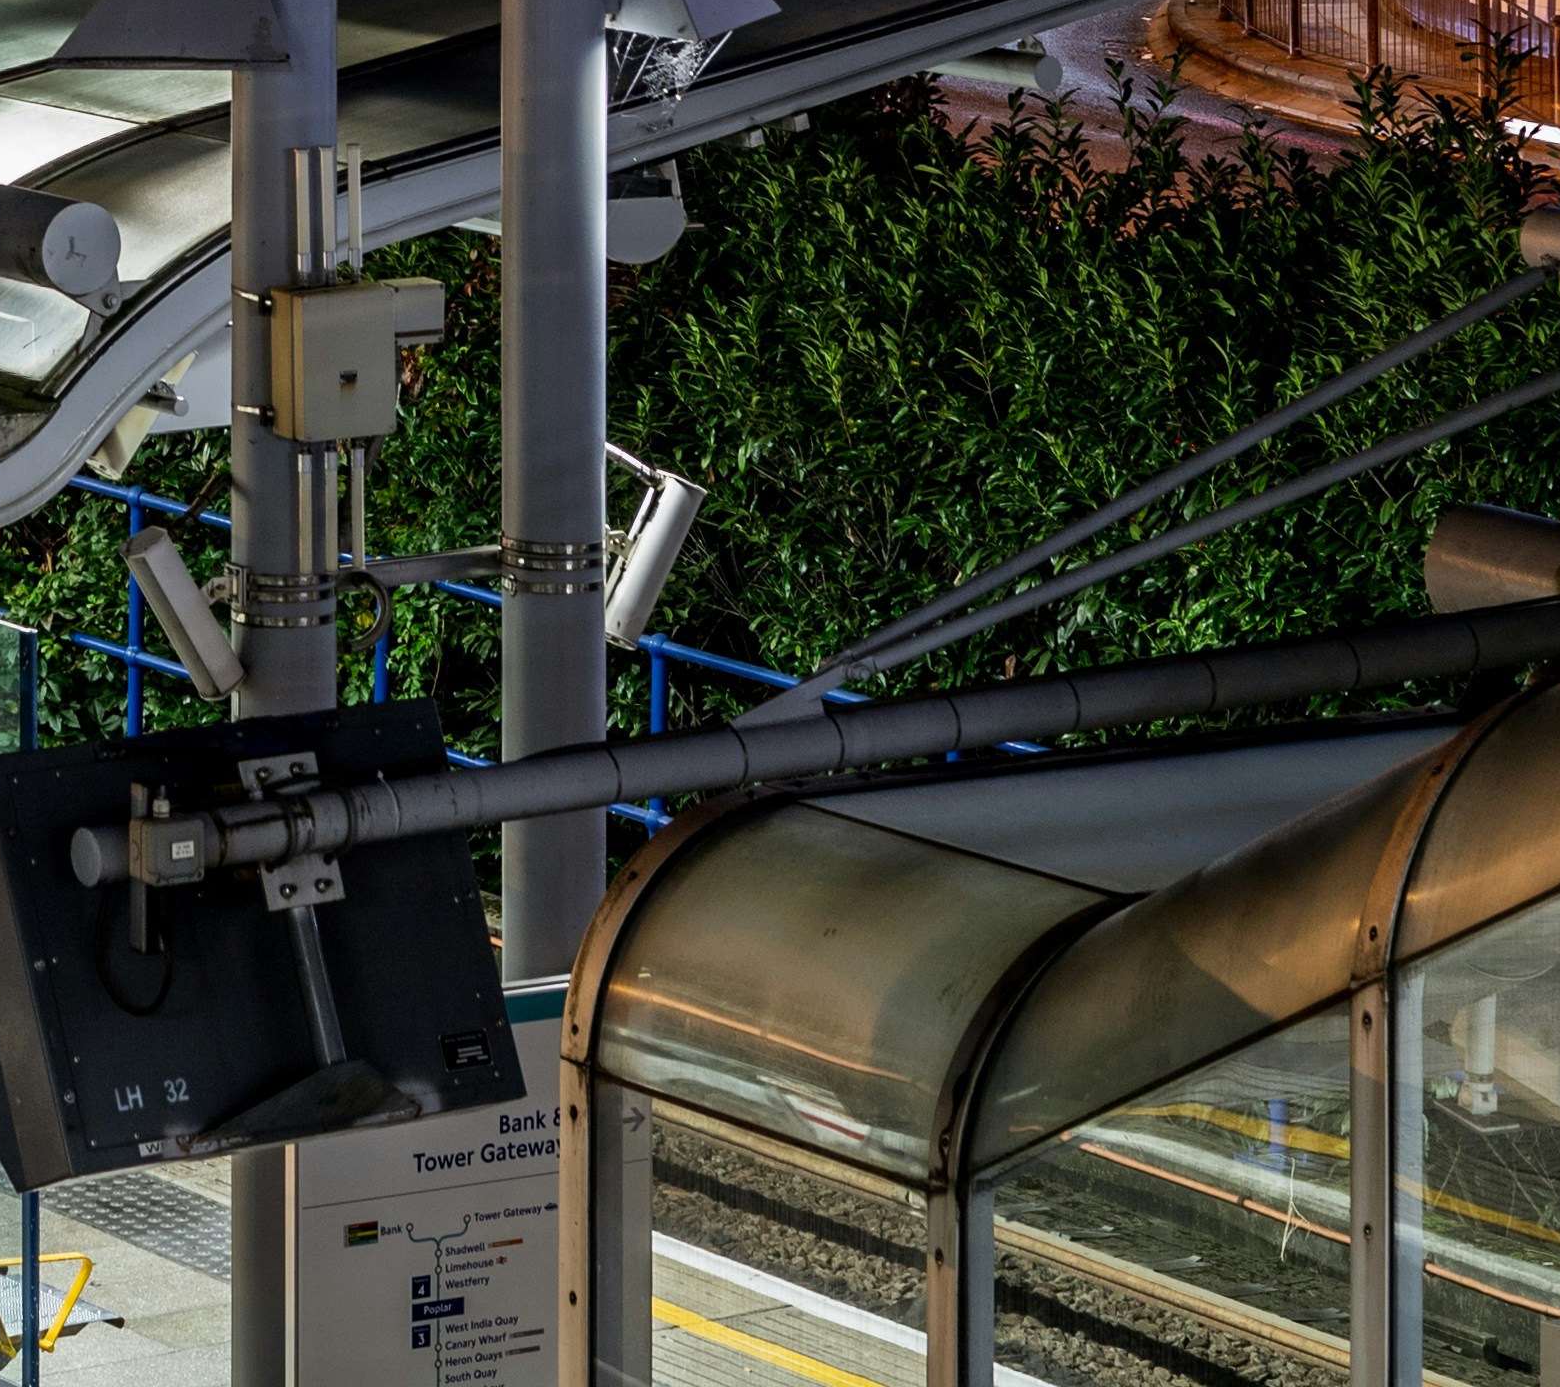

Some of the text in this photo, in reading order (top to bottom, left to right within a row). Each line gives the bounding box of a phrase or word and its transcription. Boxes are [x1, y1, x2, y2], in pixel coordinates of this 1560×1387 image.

[115, 1078, 189, 1112] LH 32
[500, 1109, 546, 1134] Bank
[413, 1148, 474, 1173] Tower
[475, 1205, 542, 1223] Tower Gateway
[380, 1224, 402, 1236] Bank
[445, 1243, 485, 1256] Shadwell
[445, 1258, 494, 1273] Limehouse
[417, 1284, 425, 1296] 4
[445, 1276, 490, 1290] Westferry
[423, 1303, 452, 1315] Poplar
[445, 1315, 519, 1334] West India Quay
[418, 1333, 425, 1345] 3
[445, 1332, 507, 1352] Canary Wharf
[445, 1350, 503, 1368] Heron Quays
[445, 1368, 498, 1385] South Quay
